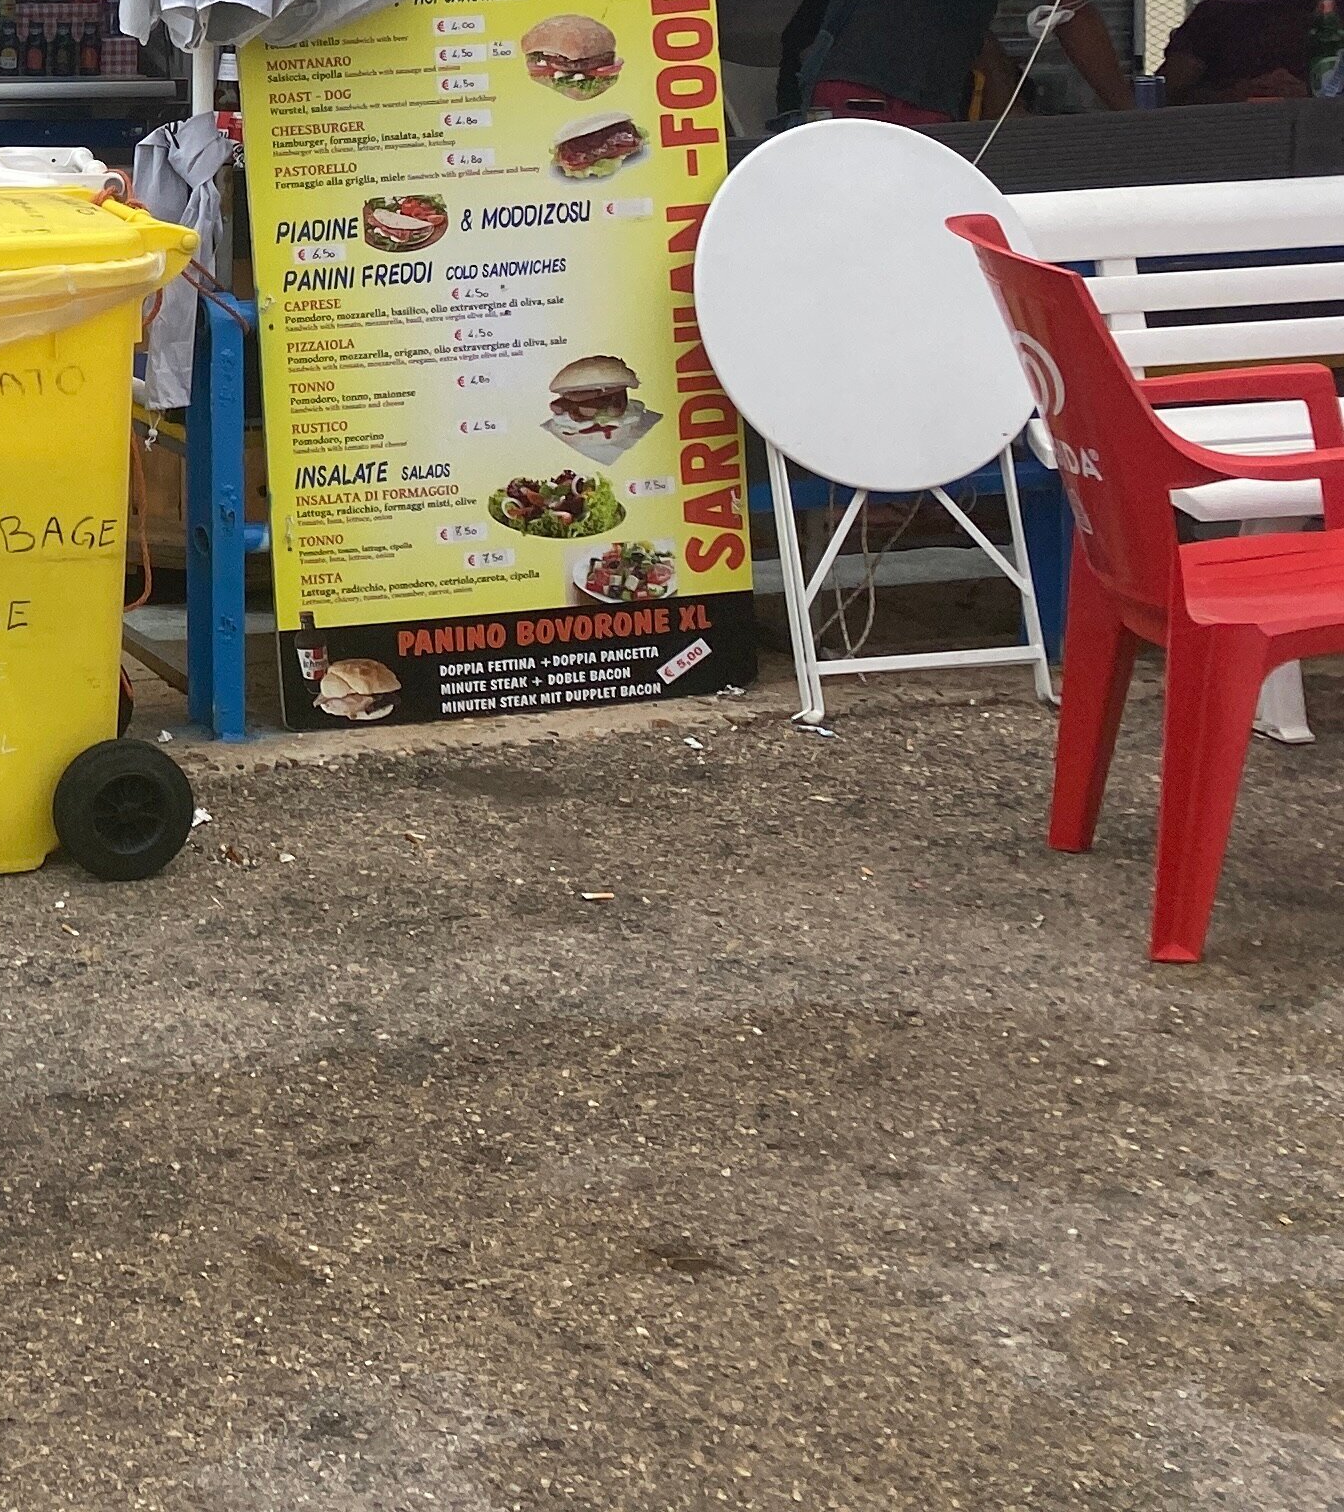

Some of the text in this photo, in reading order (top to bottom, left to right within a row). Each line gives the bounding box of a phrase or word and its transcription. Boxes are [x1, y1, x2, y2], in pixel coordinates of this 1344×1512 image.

[266, 54, 351, 72] MONTANARO
[268, 90, 312, 104] ROAST
[323, 87, 352, 101] DOG
[271, 119, 365, 138] CHEESBURGER
[274, 161, 357, 179] PASTORELLO
[460, 199, 590, 232] & MODDIZOSU
[275, 216, 358, 245] PIADINE
[282, 259, 432, 293] PANINI FREDDI
[445, 257, 566, 281] COLD SANDWICHES
[283, 297, 341, 313] CAPRESE
[286, 337, 355, 354] PIZZAIOLA
[288, 380, 335, 394] TONNO
[291, 420, 348, 435] RUSTICO
[294, 460, 388, 489] INSALATE
[400, 462, 450, 481] SALADS
[295, 483, 459, 507] INSALATA DI FORMAGGIO
[298, 533, 344, 548] TONNO
[300, 571, 342, 586] MISTA
[398, 604, 713, 656] PANINO BOVORONE XL
[439, 661, 484, 676] DOPPIA
[487, 657, 536, 674] FETTINA
[599, 646, 659, 663] PANCETTA
[440, 679, 487, 696] MINUTE
[490, 675, 528, 691] STEAK
[547, 671, 587, 686] DOBLE
[589, 666, 631, 683] BACON
[441, 681, 662, 714] MINUTEN STEAK MIT DUPPLET BACON
